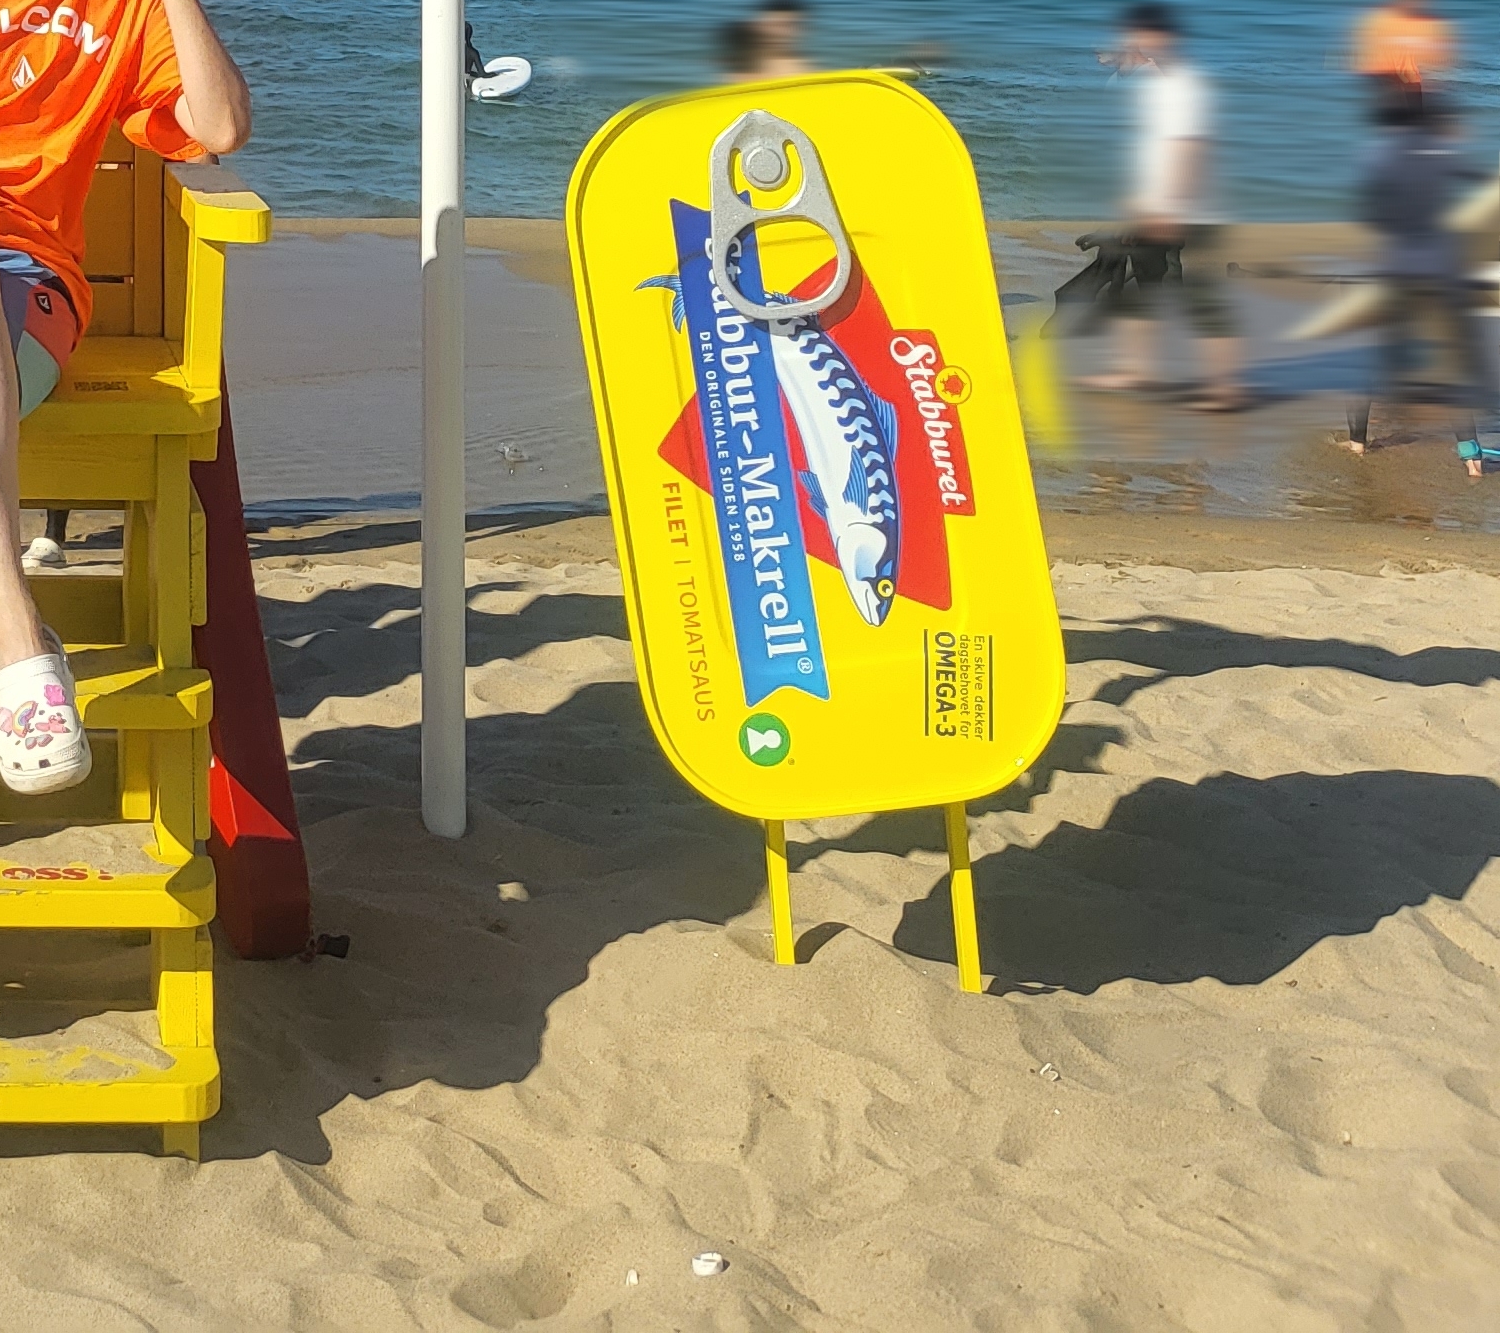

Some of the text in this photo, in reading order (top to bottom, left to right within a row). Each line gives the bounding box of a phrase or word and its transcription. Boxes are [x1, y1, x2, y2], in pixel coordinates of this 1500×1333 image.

[699, 331, 745, 562] DEN ORIGINALE SIDEN 1958
[889, 336, 967, 507] Stabburet
[663, 482, 689, 547] FILET
[677, 576, 716, 722] TOMATSAUS
[935, 631, 957, 737] OMEGA-3
[958, 634, 971, 739] dagsbehovet for
[974, 635, 985, 741] En skive dekker
